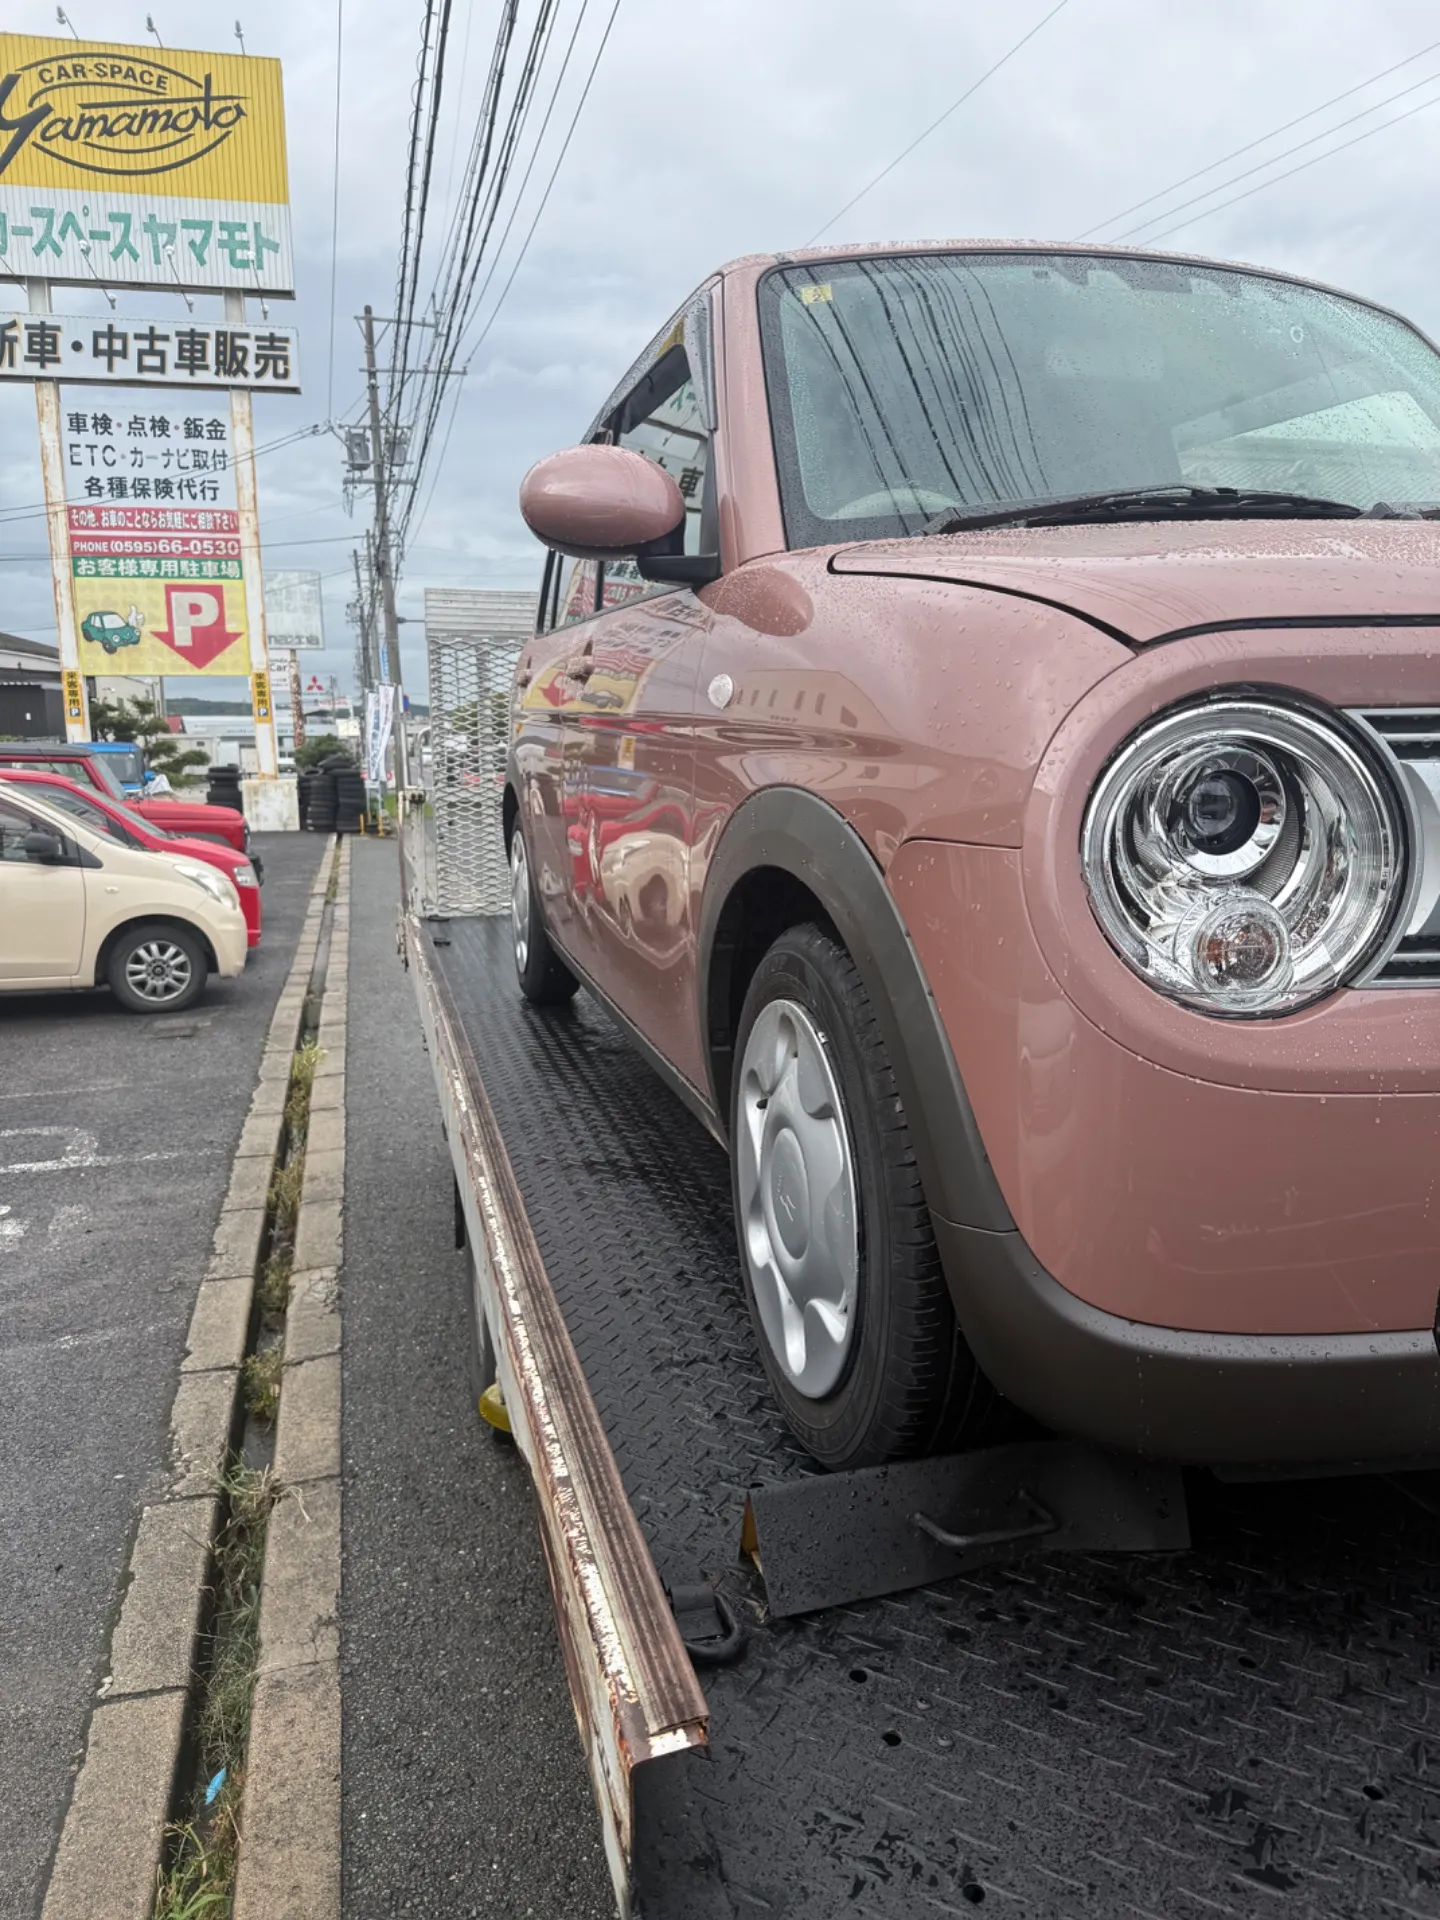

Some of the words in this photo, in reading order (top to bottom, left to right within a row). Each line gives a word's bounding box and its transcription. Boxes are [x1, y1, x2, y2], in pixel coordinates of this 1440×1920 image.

[67, 412, 227, 441] 車検・点検・鈑金
[69, 444, 228, 471] ETC・カーナビ取付
[84, 476, 220, 501] 各種保険代行
[73, 541, 109, 552] PHONE
[77, 557, 240, 579] お客様専用駐車場
[170, 591, 219, 647] P
